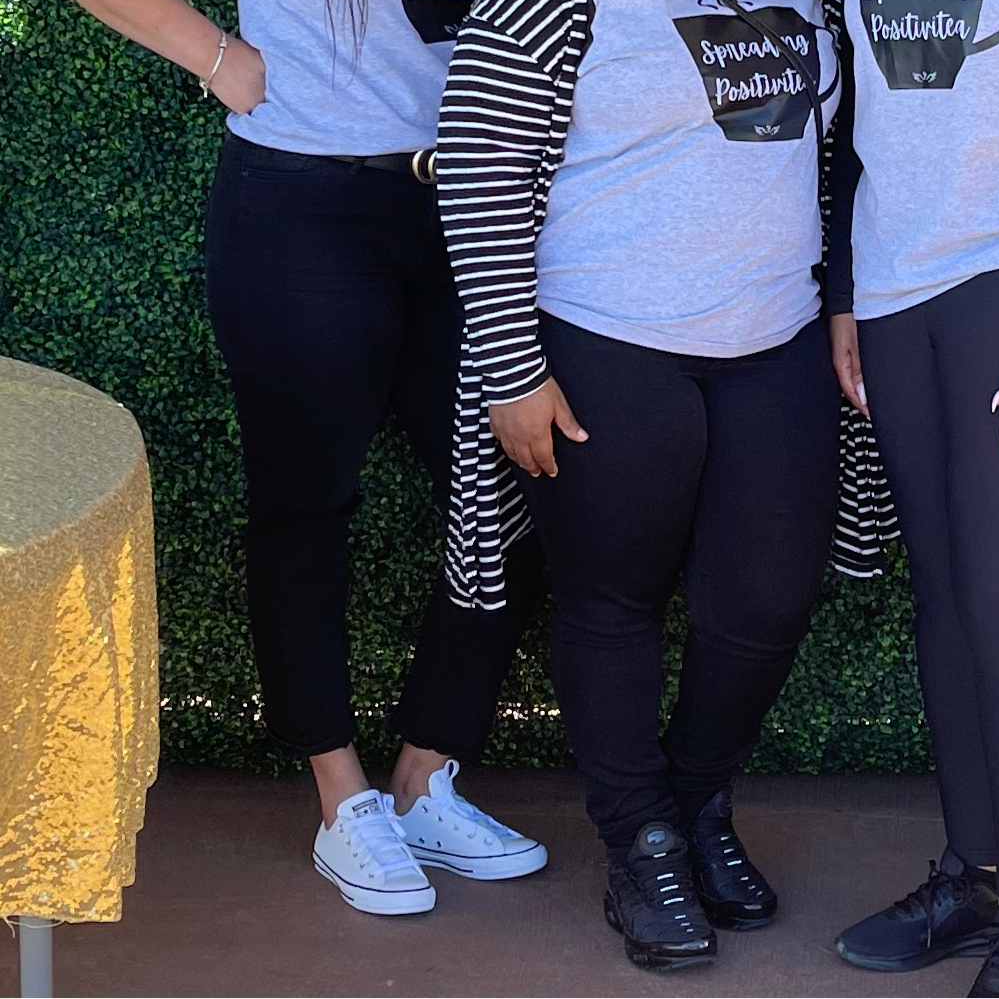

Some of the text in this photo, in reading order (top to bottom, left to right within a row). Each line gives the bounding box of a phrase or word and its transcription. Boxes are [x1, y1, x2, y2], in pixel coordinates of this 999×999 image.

[871, 10, 971, 42] Positivitea
[700, 34, 809, 68] Spreadng
[715, 67, 812, 106] Positivite
